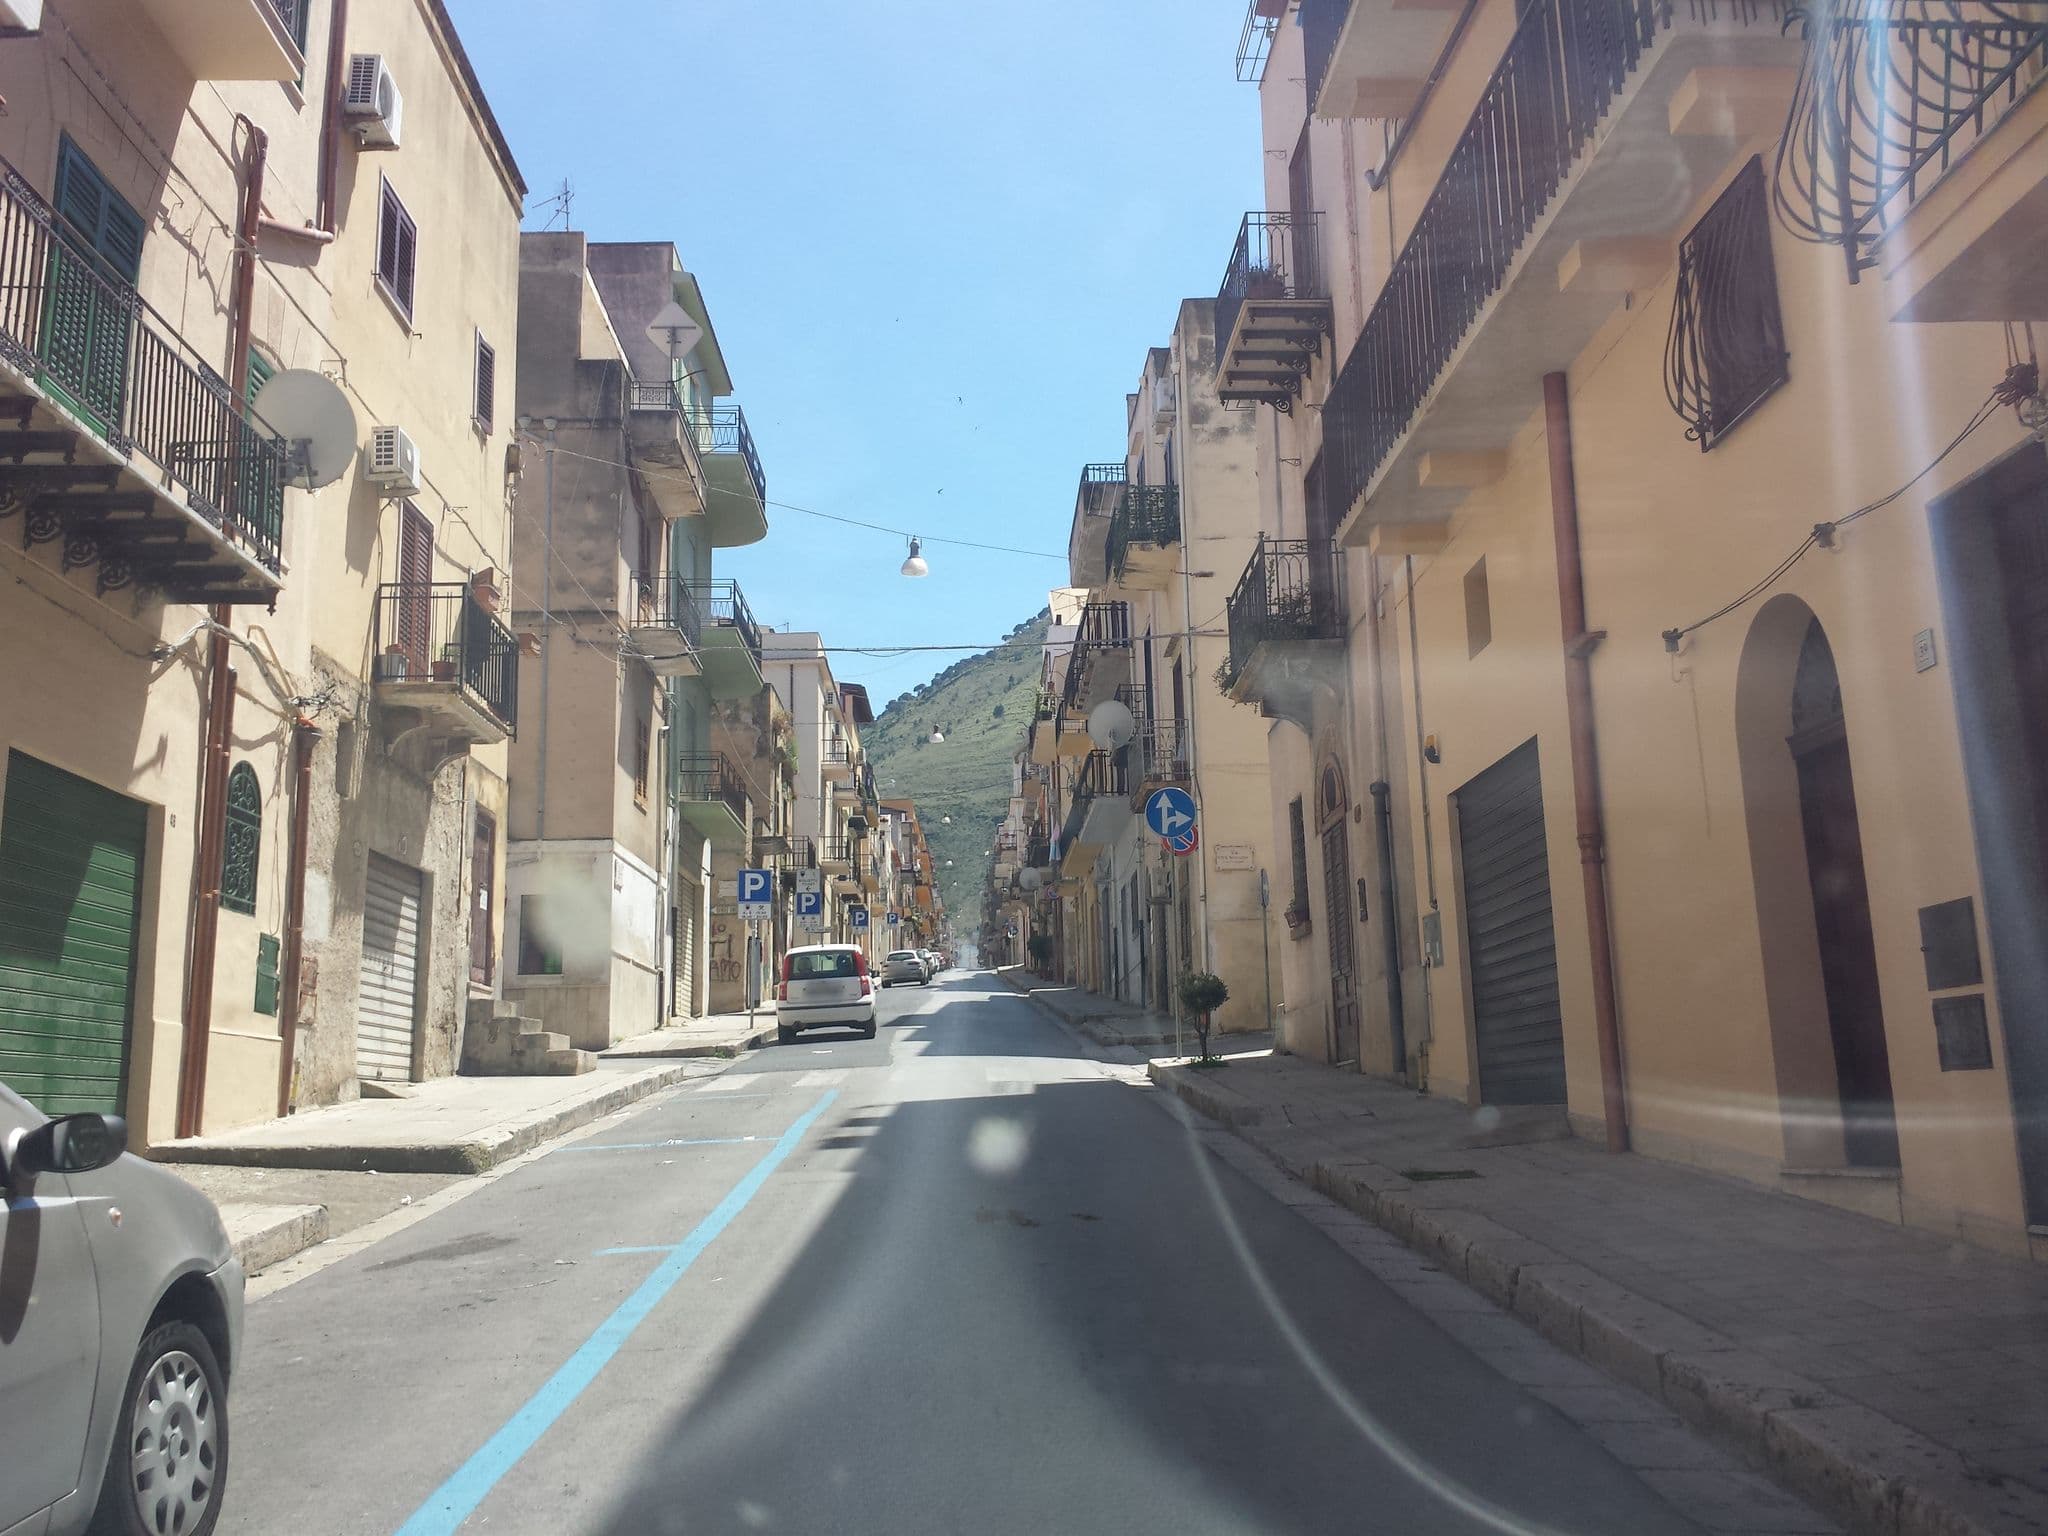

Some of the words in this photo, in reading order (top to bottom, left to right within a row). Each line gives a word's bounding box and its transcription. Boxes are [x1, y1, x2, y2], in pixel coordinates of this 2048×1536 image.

[745, 872, 765, 900] P
[801, 893, 816, 913] P
[855, 911, 866, 925] P
[889, 913, 897, 923] P
